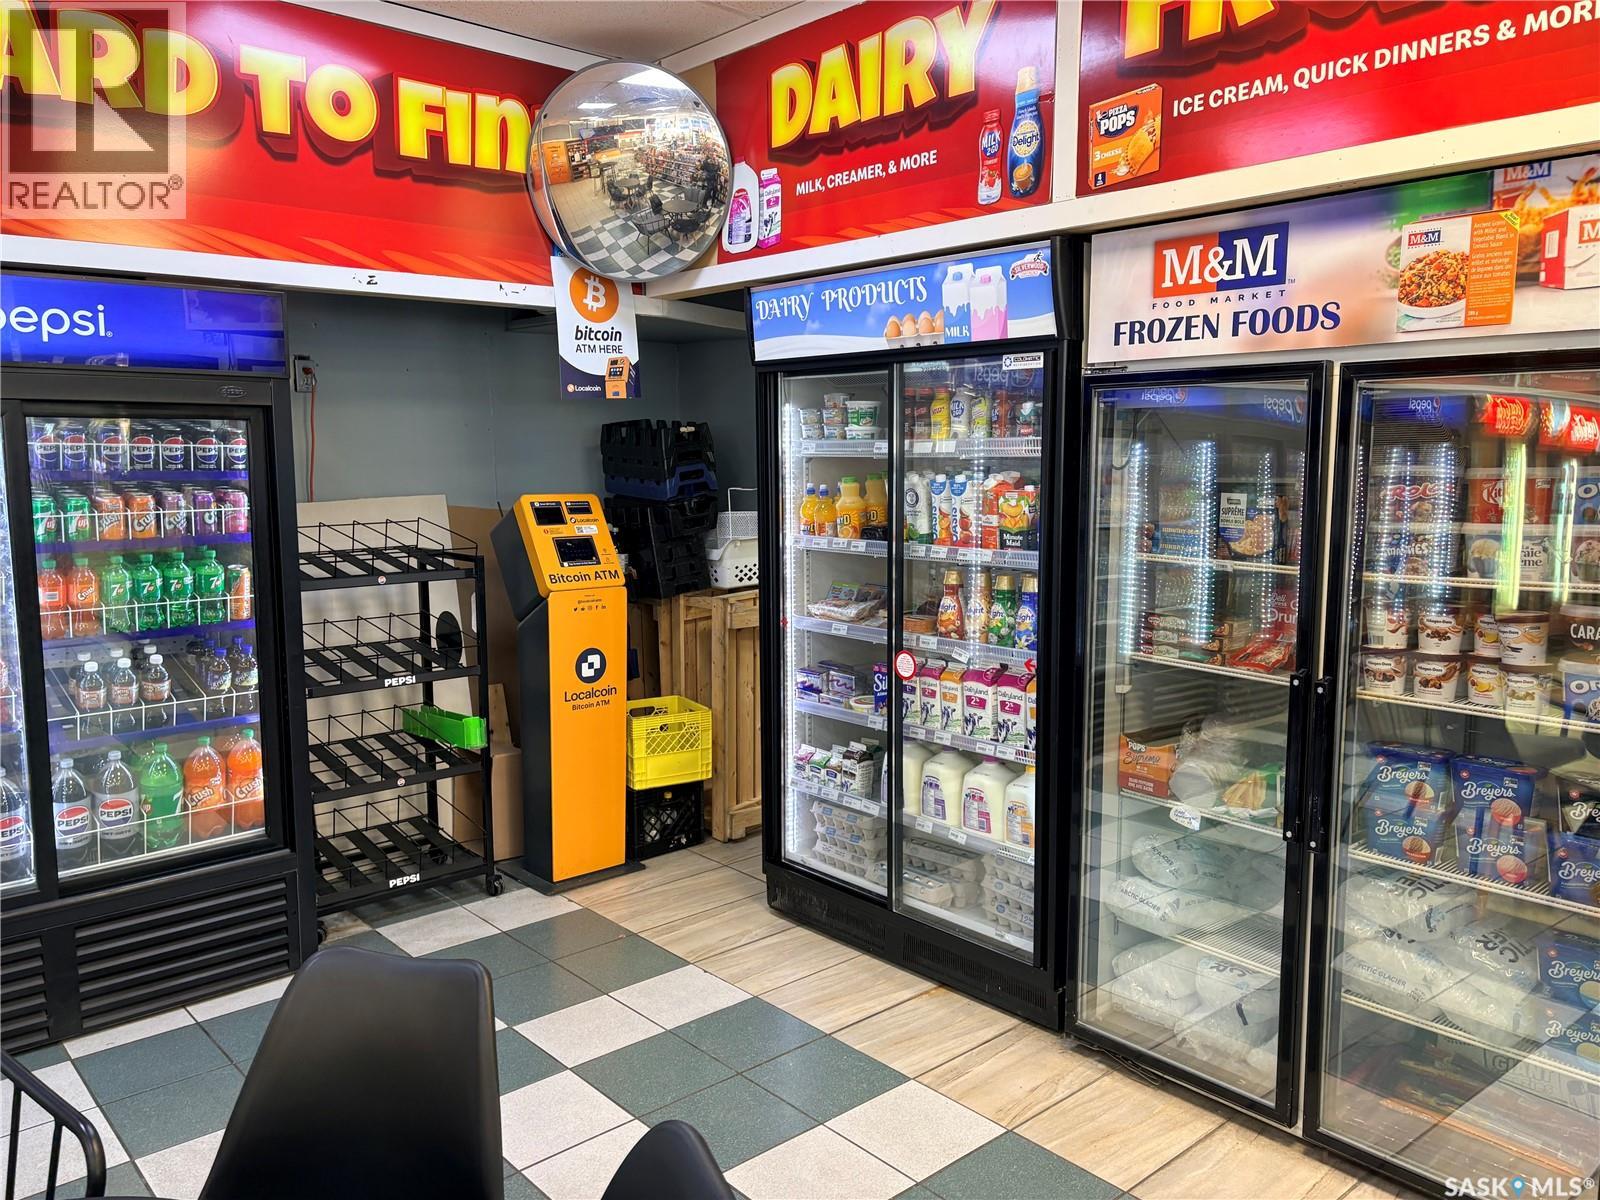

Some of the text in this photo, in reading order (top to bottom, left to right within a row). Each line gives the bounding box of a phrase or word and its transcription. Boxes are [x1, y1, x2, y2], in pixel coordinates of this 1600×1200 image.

[770, 0, 1000, 149] DAIRY
[1173, 94, 1204, 118] ICE
[1208, 73, 1289, 109] CREAM,
[1293, 55, 1369, 89] QUICK
[1373, 29, 1490, 71] DINNERS
[1496, 20, 1516, 41] &
[238, 44, 378, 142] TO
[1108, 104, 1128, 117] PIZZA
[1100, 110, 1136, 135] POPS
[1012, 132, 1040, 147] Delight
[795, 149, 938, 197] MILK, CREAMER, & MORE
[1410, 232, 1439, 245] M&M
[1161, 232, 1278, 289] M&M
[755, 275, 929, 321] DAIRY PRODUCTS
[1152, 288, 1287, 309] FOOD MARKET
[944, 324, 970, 338] MILK
[1113, 301, 1341, 347] FROZEN FOODS
[574, 325, 622, 342] bitcoin
[575, 344, 623, 354] ATM HERE
[574, 384, 602, 393] Localcoin
[549, 569, 620, 585] Bitcoin ATM
[384, 674, 417, 688] PEPSI
[564, 685, 617, 703] Localcoin
[571, 698, 611, 712] Bitcoin ATM
[1377, 766, 1430, 784] Breyers
[1461, 781, 1516, 801] Breyers
[57, 814, 89, 828] PEPSI
[100, 807, 132, 818] PEPSI
[1375, 819, 1426, 837] Breyers
[1466, 837, 1521, 856] Breyers
[389, 873, 421, 888] PEPSI
